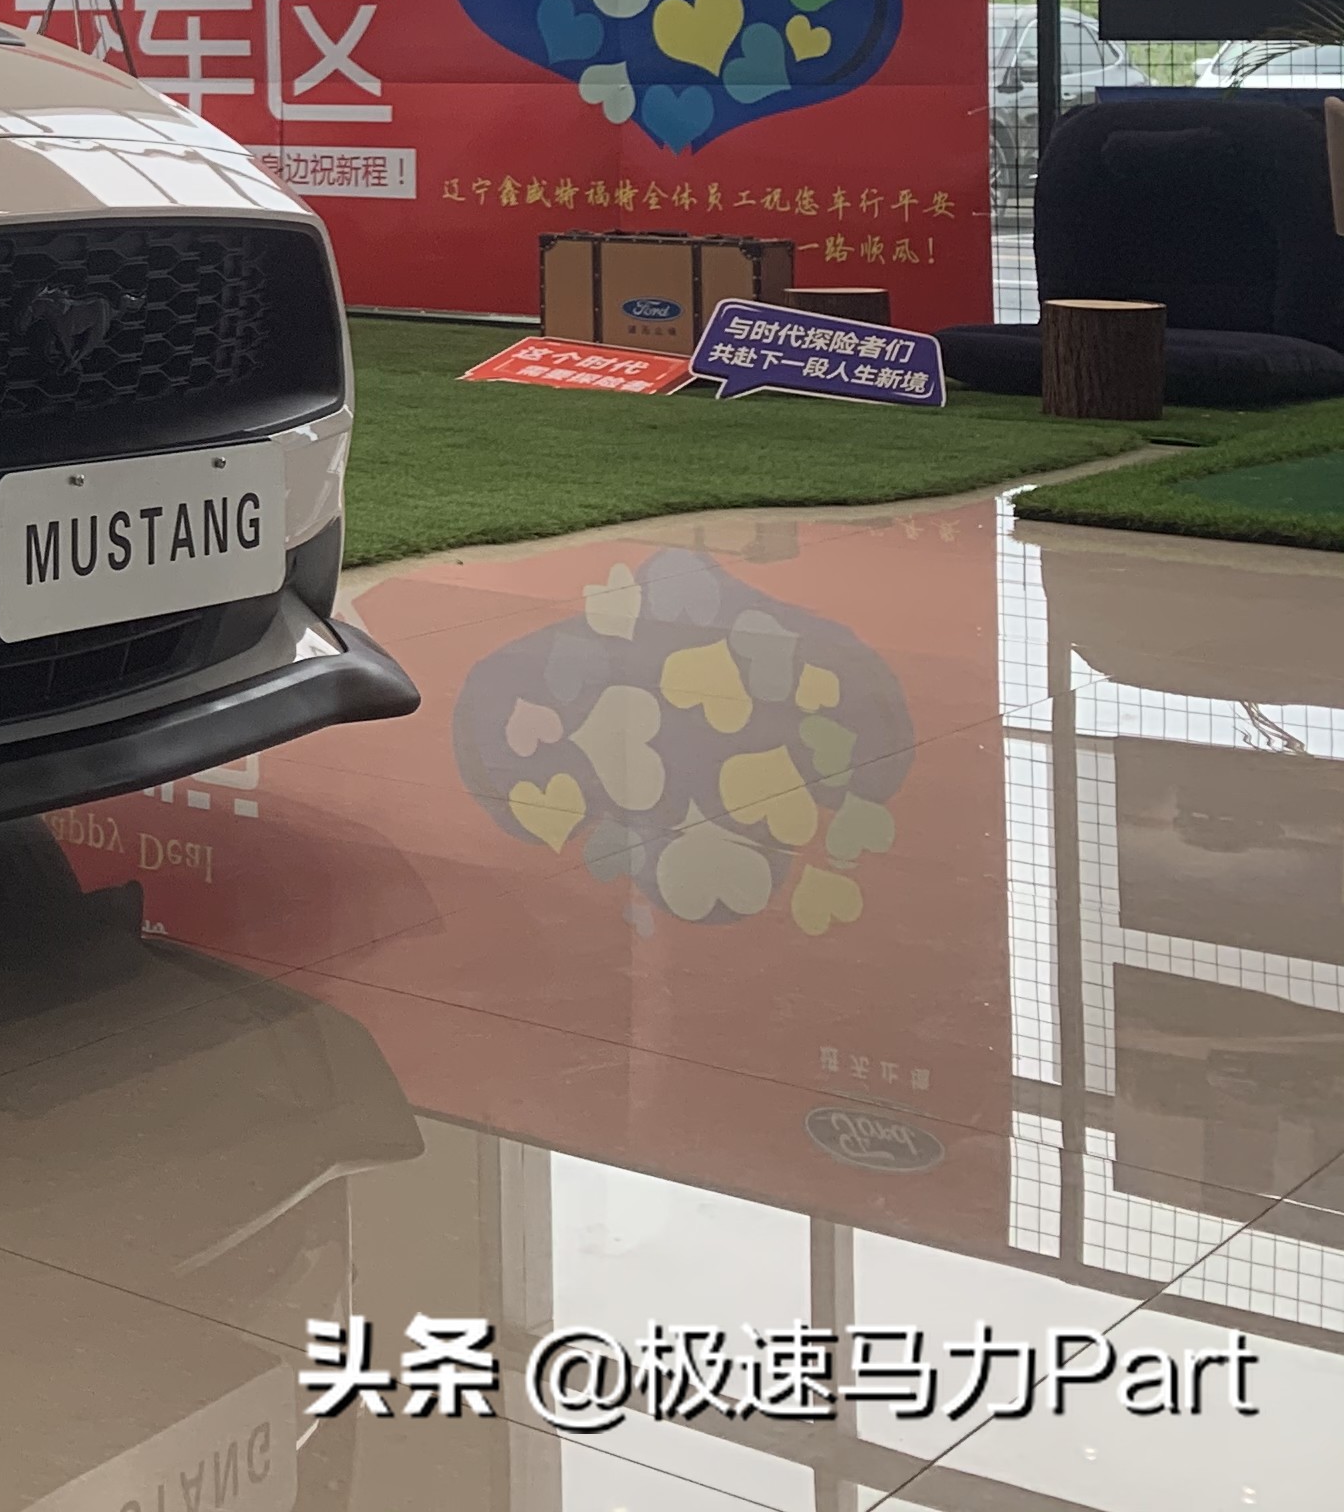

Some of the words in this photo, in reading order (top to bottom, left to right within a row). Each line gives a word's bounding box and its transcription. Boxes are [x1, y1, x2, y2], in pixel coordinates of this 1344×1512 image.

[632, 299, 670, 317] Ford
[511, 345, 650, 375] 这个时代
[724, 316, 916, 364] 与时代探险者们
[708, 343, 930, 394] 共赴下一段人生新境
[25, 491, 261, 586] MUSTANG
